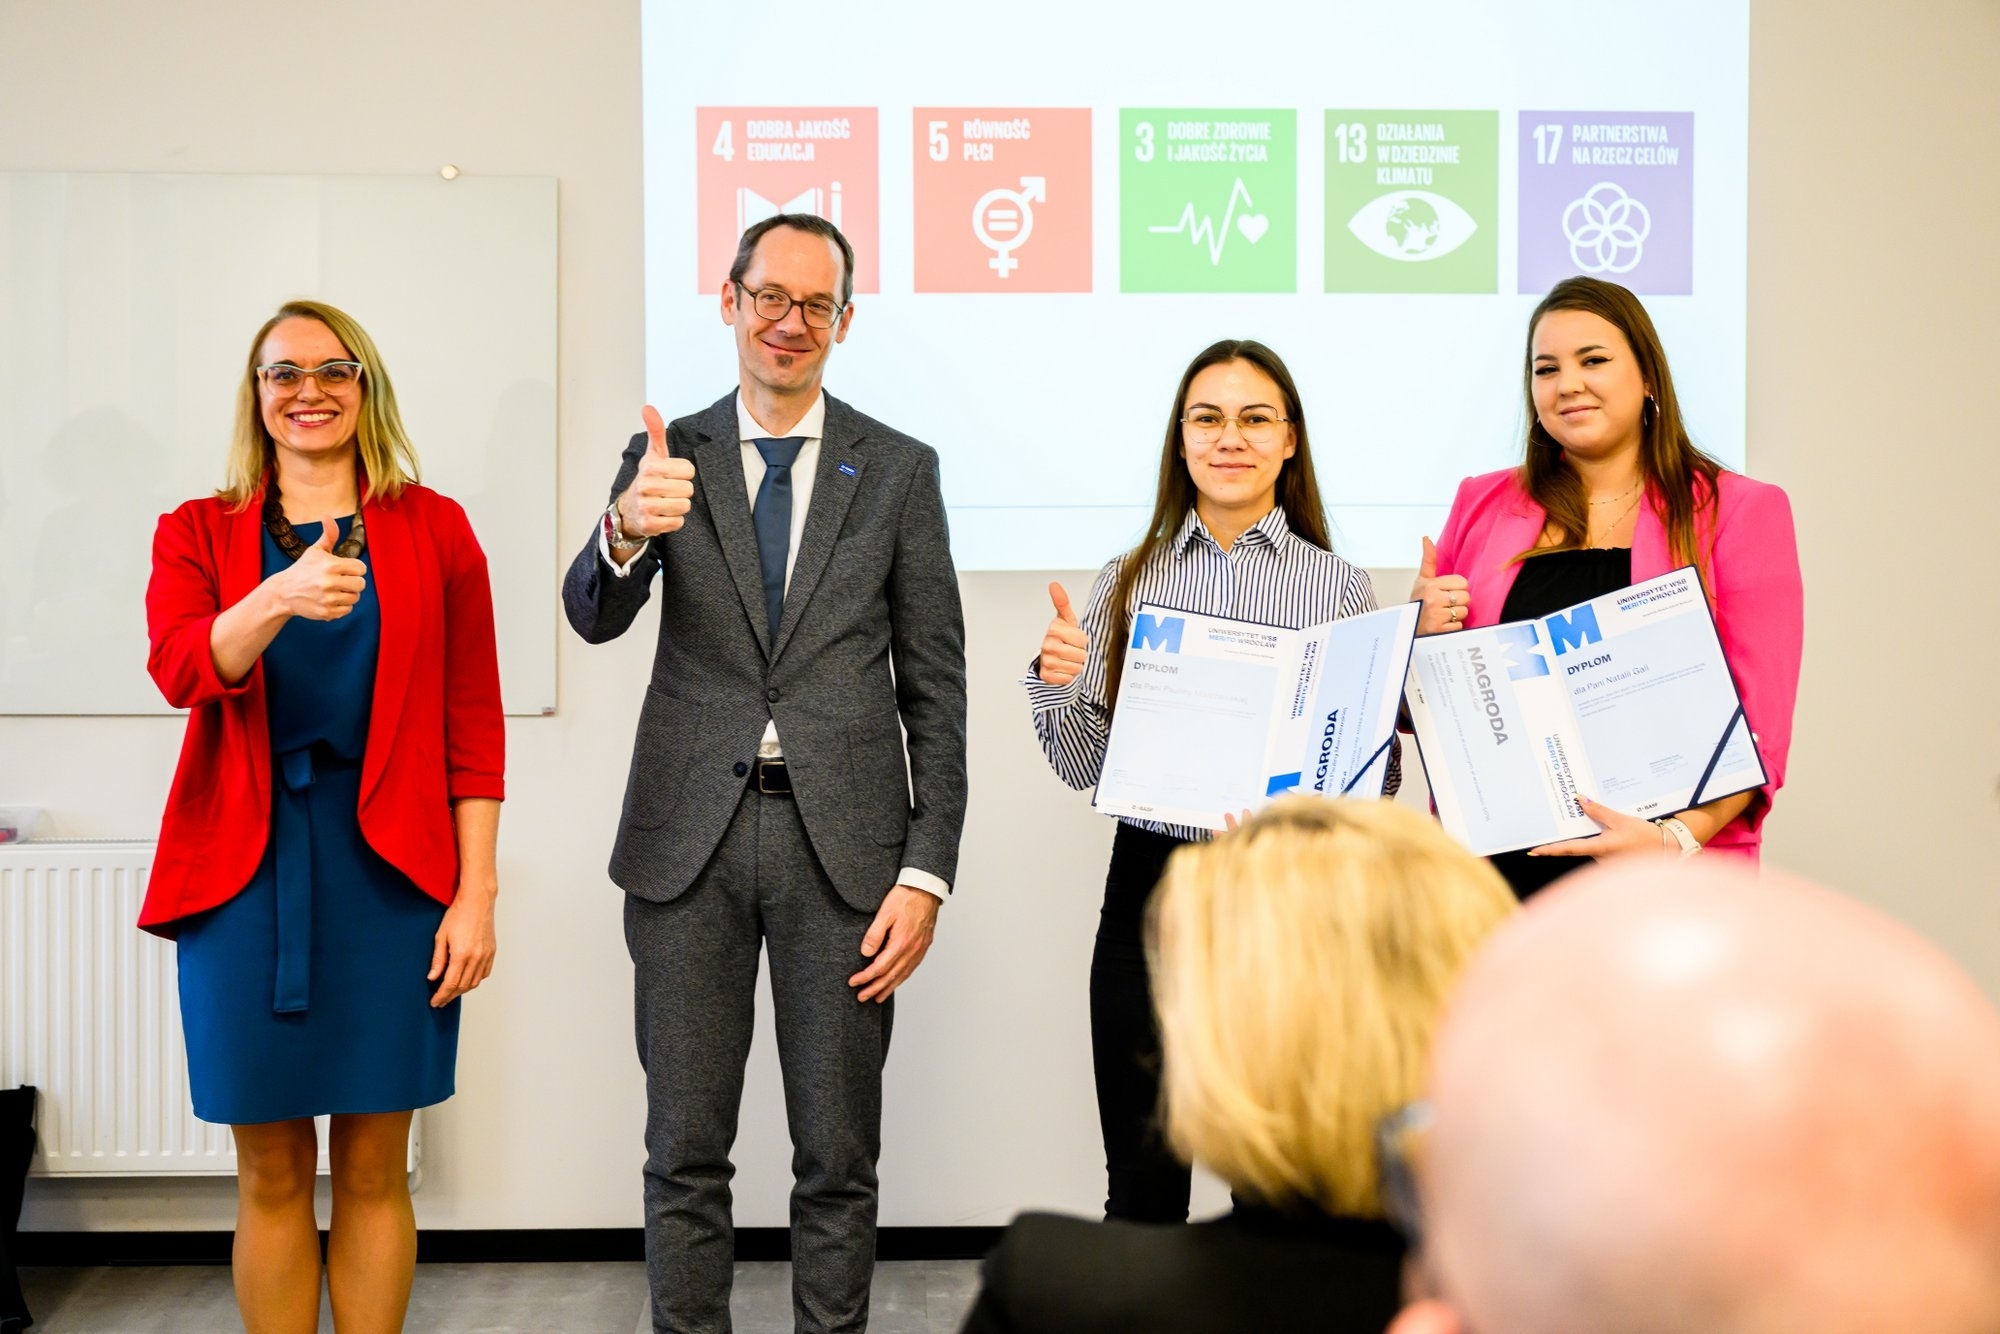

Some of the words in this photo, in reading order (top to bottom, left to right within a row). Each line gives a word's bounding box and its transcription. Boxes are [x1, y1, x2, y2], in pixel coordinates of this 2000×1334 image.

[747, 120, 793, 138] DOBRA
[795, 117, 851, 139] JAKOŚĆ
[963, 117, 1031, 140] RÓWNOŚĆ
[1167, 121, 1211, 140] DOBRE
[1213, 121, 1272, 140] ZDROWIE
[1377, 123, 1445, 141] DZIAŁANIA
[1572, 124, 1669, 143] PARTNERSTWA
[712, 120, 735, 161] 4
[929, 121, 949, 162] 5
[963, 142, 994, 161] PŁCI
[1135, 122, 1154, 162] 3
[1167, 144, 1173, 162] I
[1174, 141, 1227, 162] JAKOŚĆ
[1228, 141, 1268, 162] ŻYCIA
[1335, 122, 1367, 163] 13
[1533, 124, 1563, 165] 17
[747, 143, 815, 161] EDUKACJI
[1377, 145, 1390, 163] W
[1391, 145, 1460, 164] DZIEDZINIE
[1572, 147, 1591, 165] NA
[1592, 147, 1633, 165] RZECZ
[1634, 145, 1680, 166] CELÓW
[1377, 167, 1433, 185] KLIMATU
[1616, 584, 1669, 606] UNIWERSYTET
[1669, 578, 1687, 590] WSB
[1620, 599, 1649, 612] MERITO
[1131, 613, 1186, 655] M
[1208, 627, 1259, 640] UNIWERSYTET
[1208, 634, 1237, 643] MERITO
[1545, 602, 1603, 656] M
[1133, 661, 1179, 675] DYPLOM
[1566, 653, 1612, 676] DYPLOM
[1467, 646, 1509, 747] NAGRODA
[1573, 681, 1586, 696] dla
[1586, 676, 1605, 692] Pani
[1313, 708, 1339, 792] AGRODA
[1543, 735, 1561, 770] MERITO
[1552, 733, 1577, 795] UNIWERSYTET
